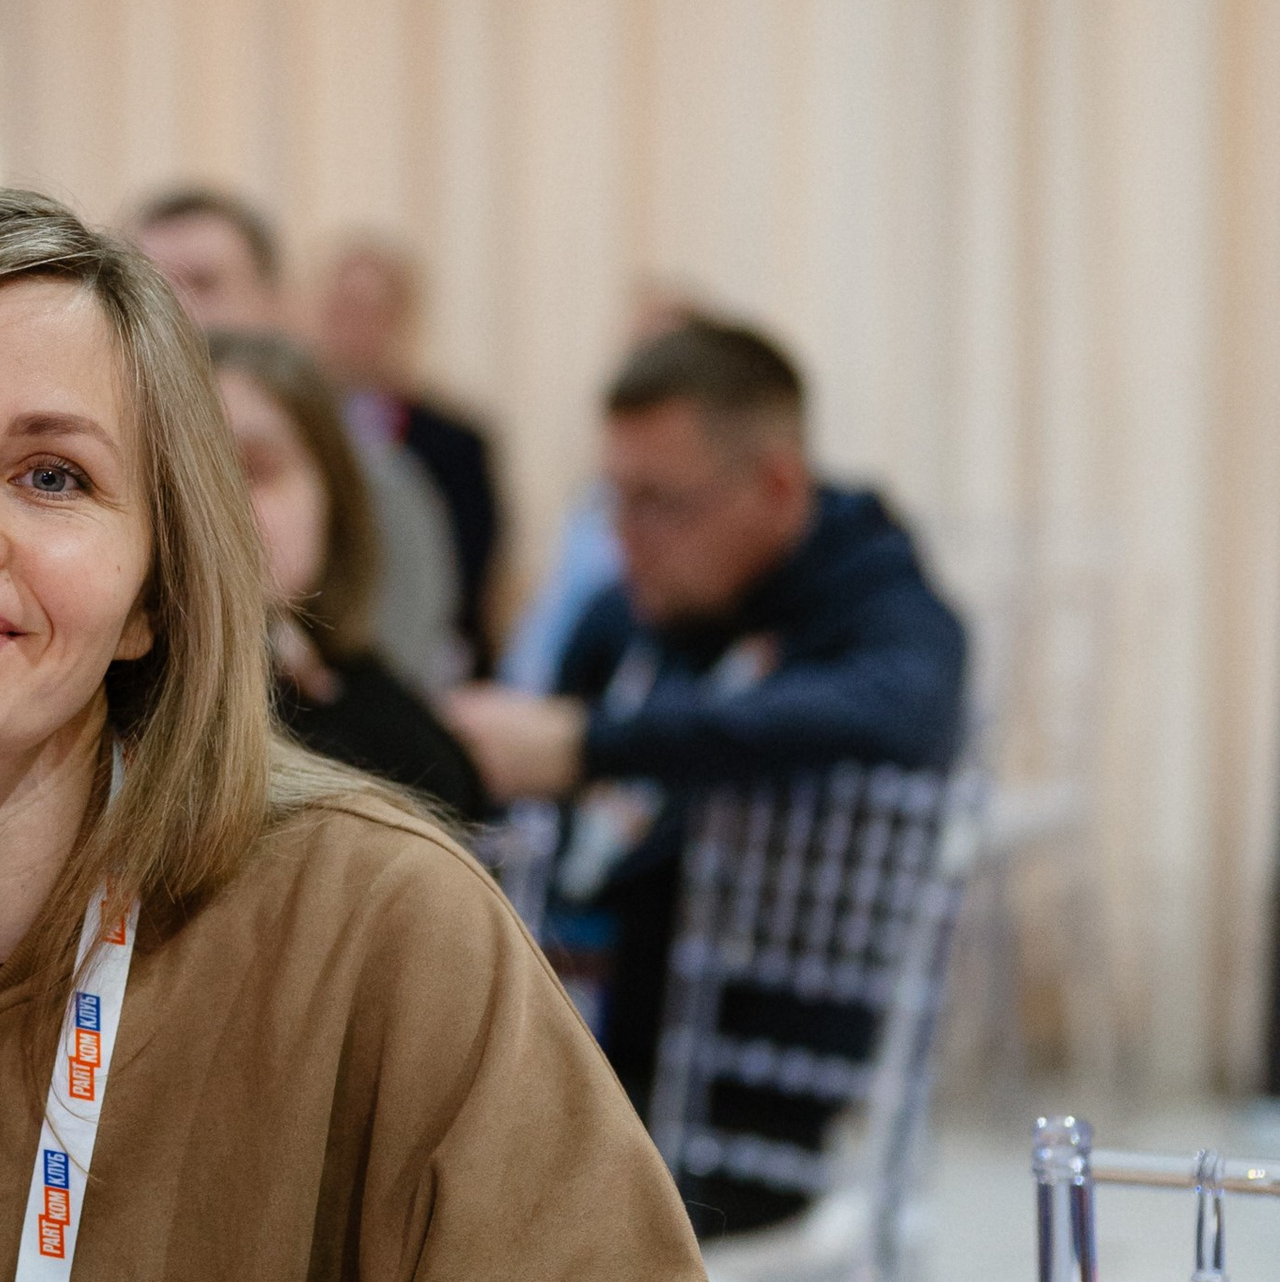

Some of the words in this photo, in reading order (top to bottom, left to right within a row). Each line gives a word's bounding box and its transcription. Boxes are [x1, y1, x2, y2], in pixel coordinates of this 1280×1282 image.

[79, 994, 98, 1029] КЛУБ
[79, 1032, 99, 1064] KOM
[48, 1150, 66, 1186] КЛУБ
[49, 1190, 67, 1221] KOM
[42, 1219, 61, 1256] PART
